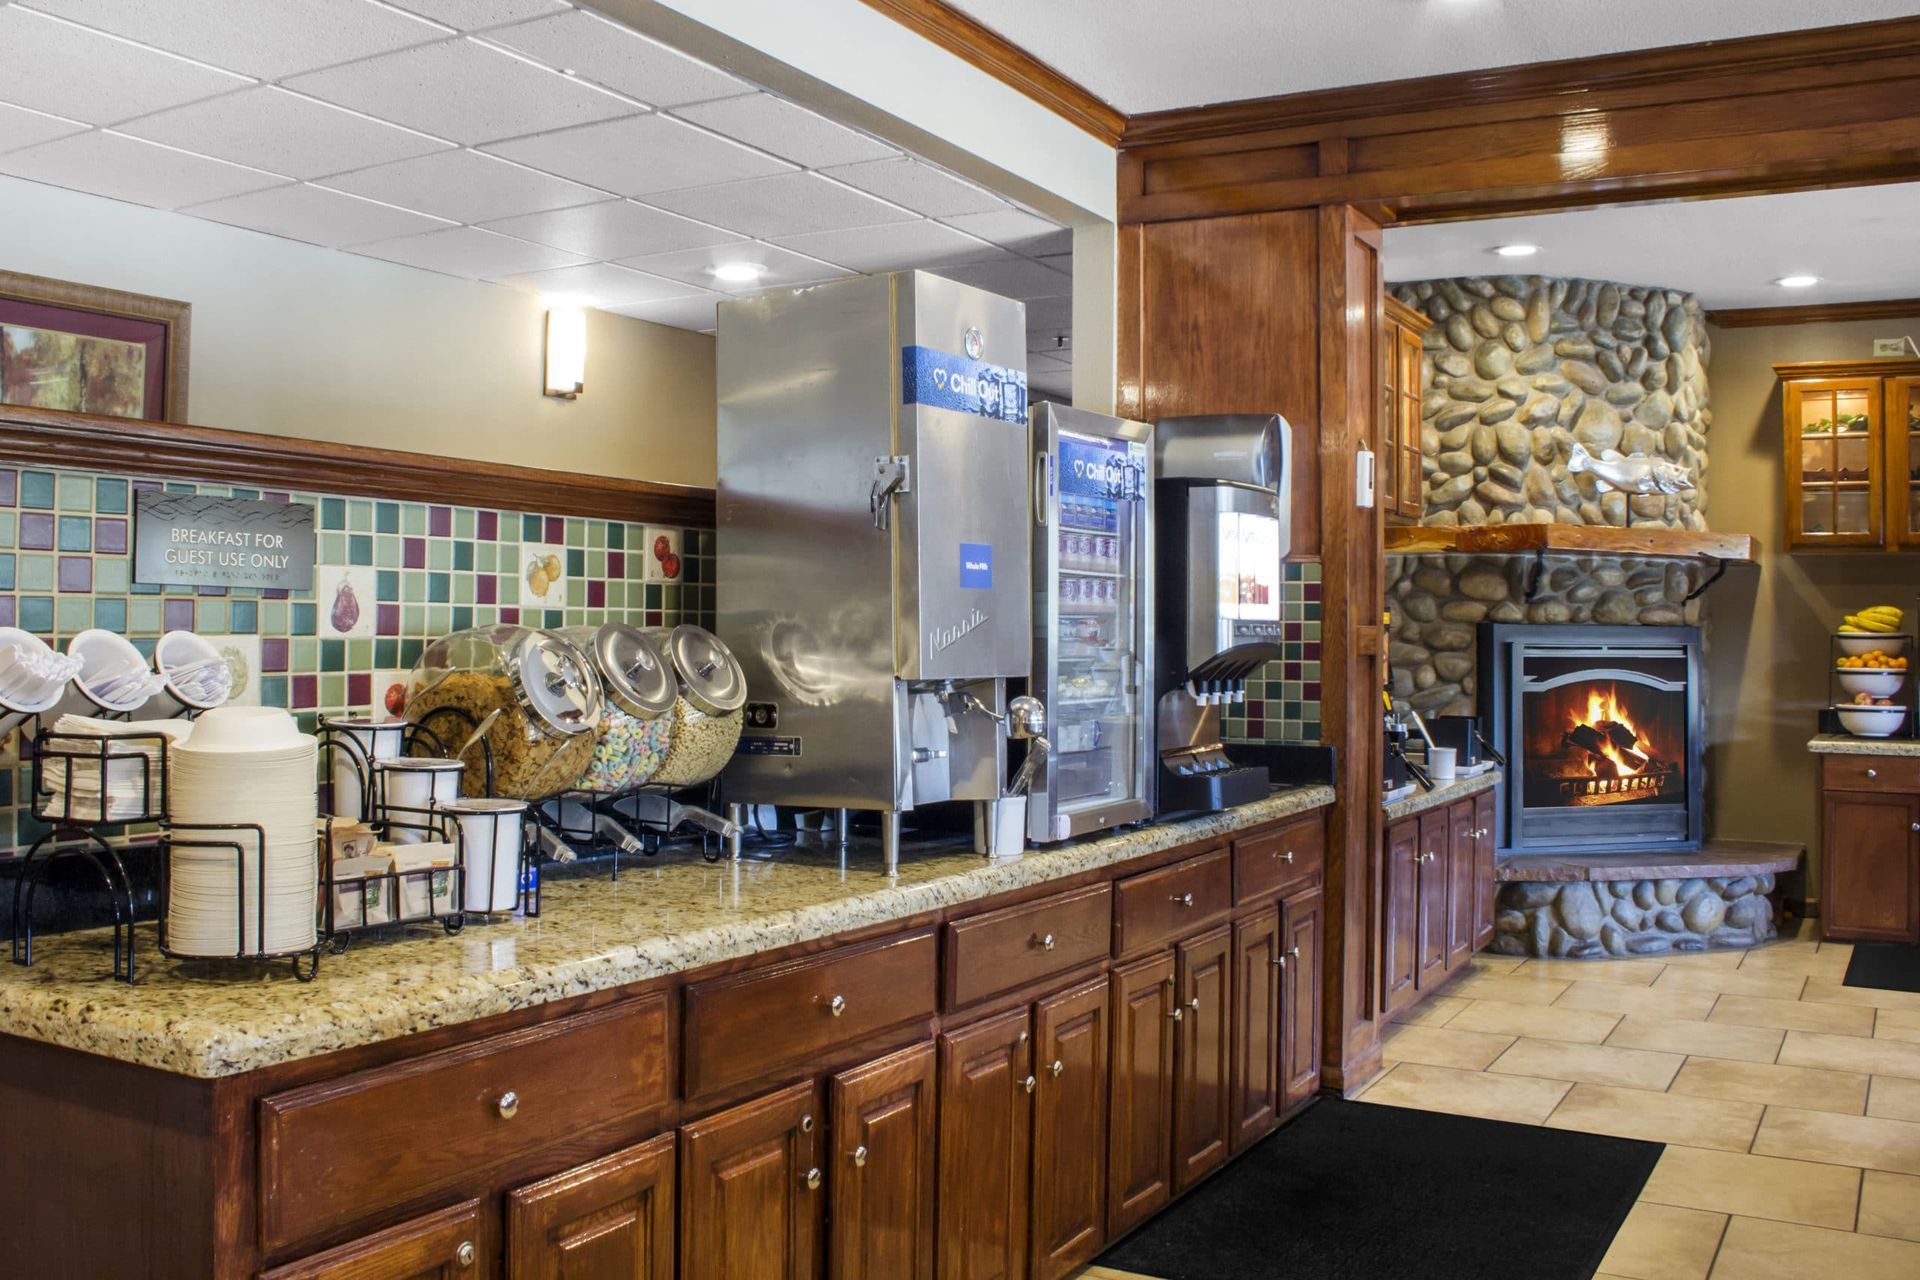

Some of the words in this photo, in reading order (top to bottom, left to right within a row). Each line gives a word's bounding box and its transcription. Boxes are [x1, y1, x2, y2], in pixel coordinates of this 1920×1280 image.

[950, 373, 977, 397] Chill
[978, 380, 1000, 402] Out
[1086, 462, 1105, 481] Chill
[1105, 466, 1122, 484] Out
[171, 528, 250, 547] BREAKFAST
[255, 533, 284, 549] FOR
[164, 548, 214, 565] GUEST
[218, 552, 246, 567] USE
[250, 553, 289, 569] ONLY
